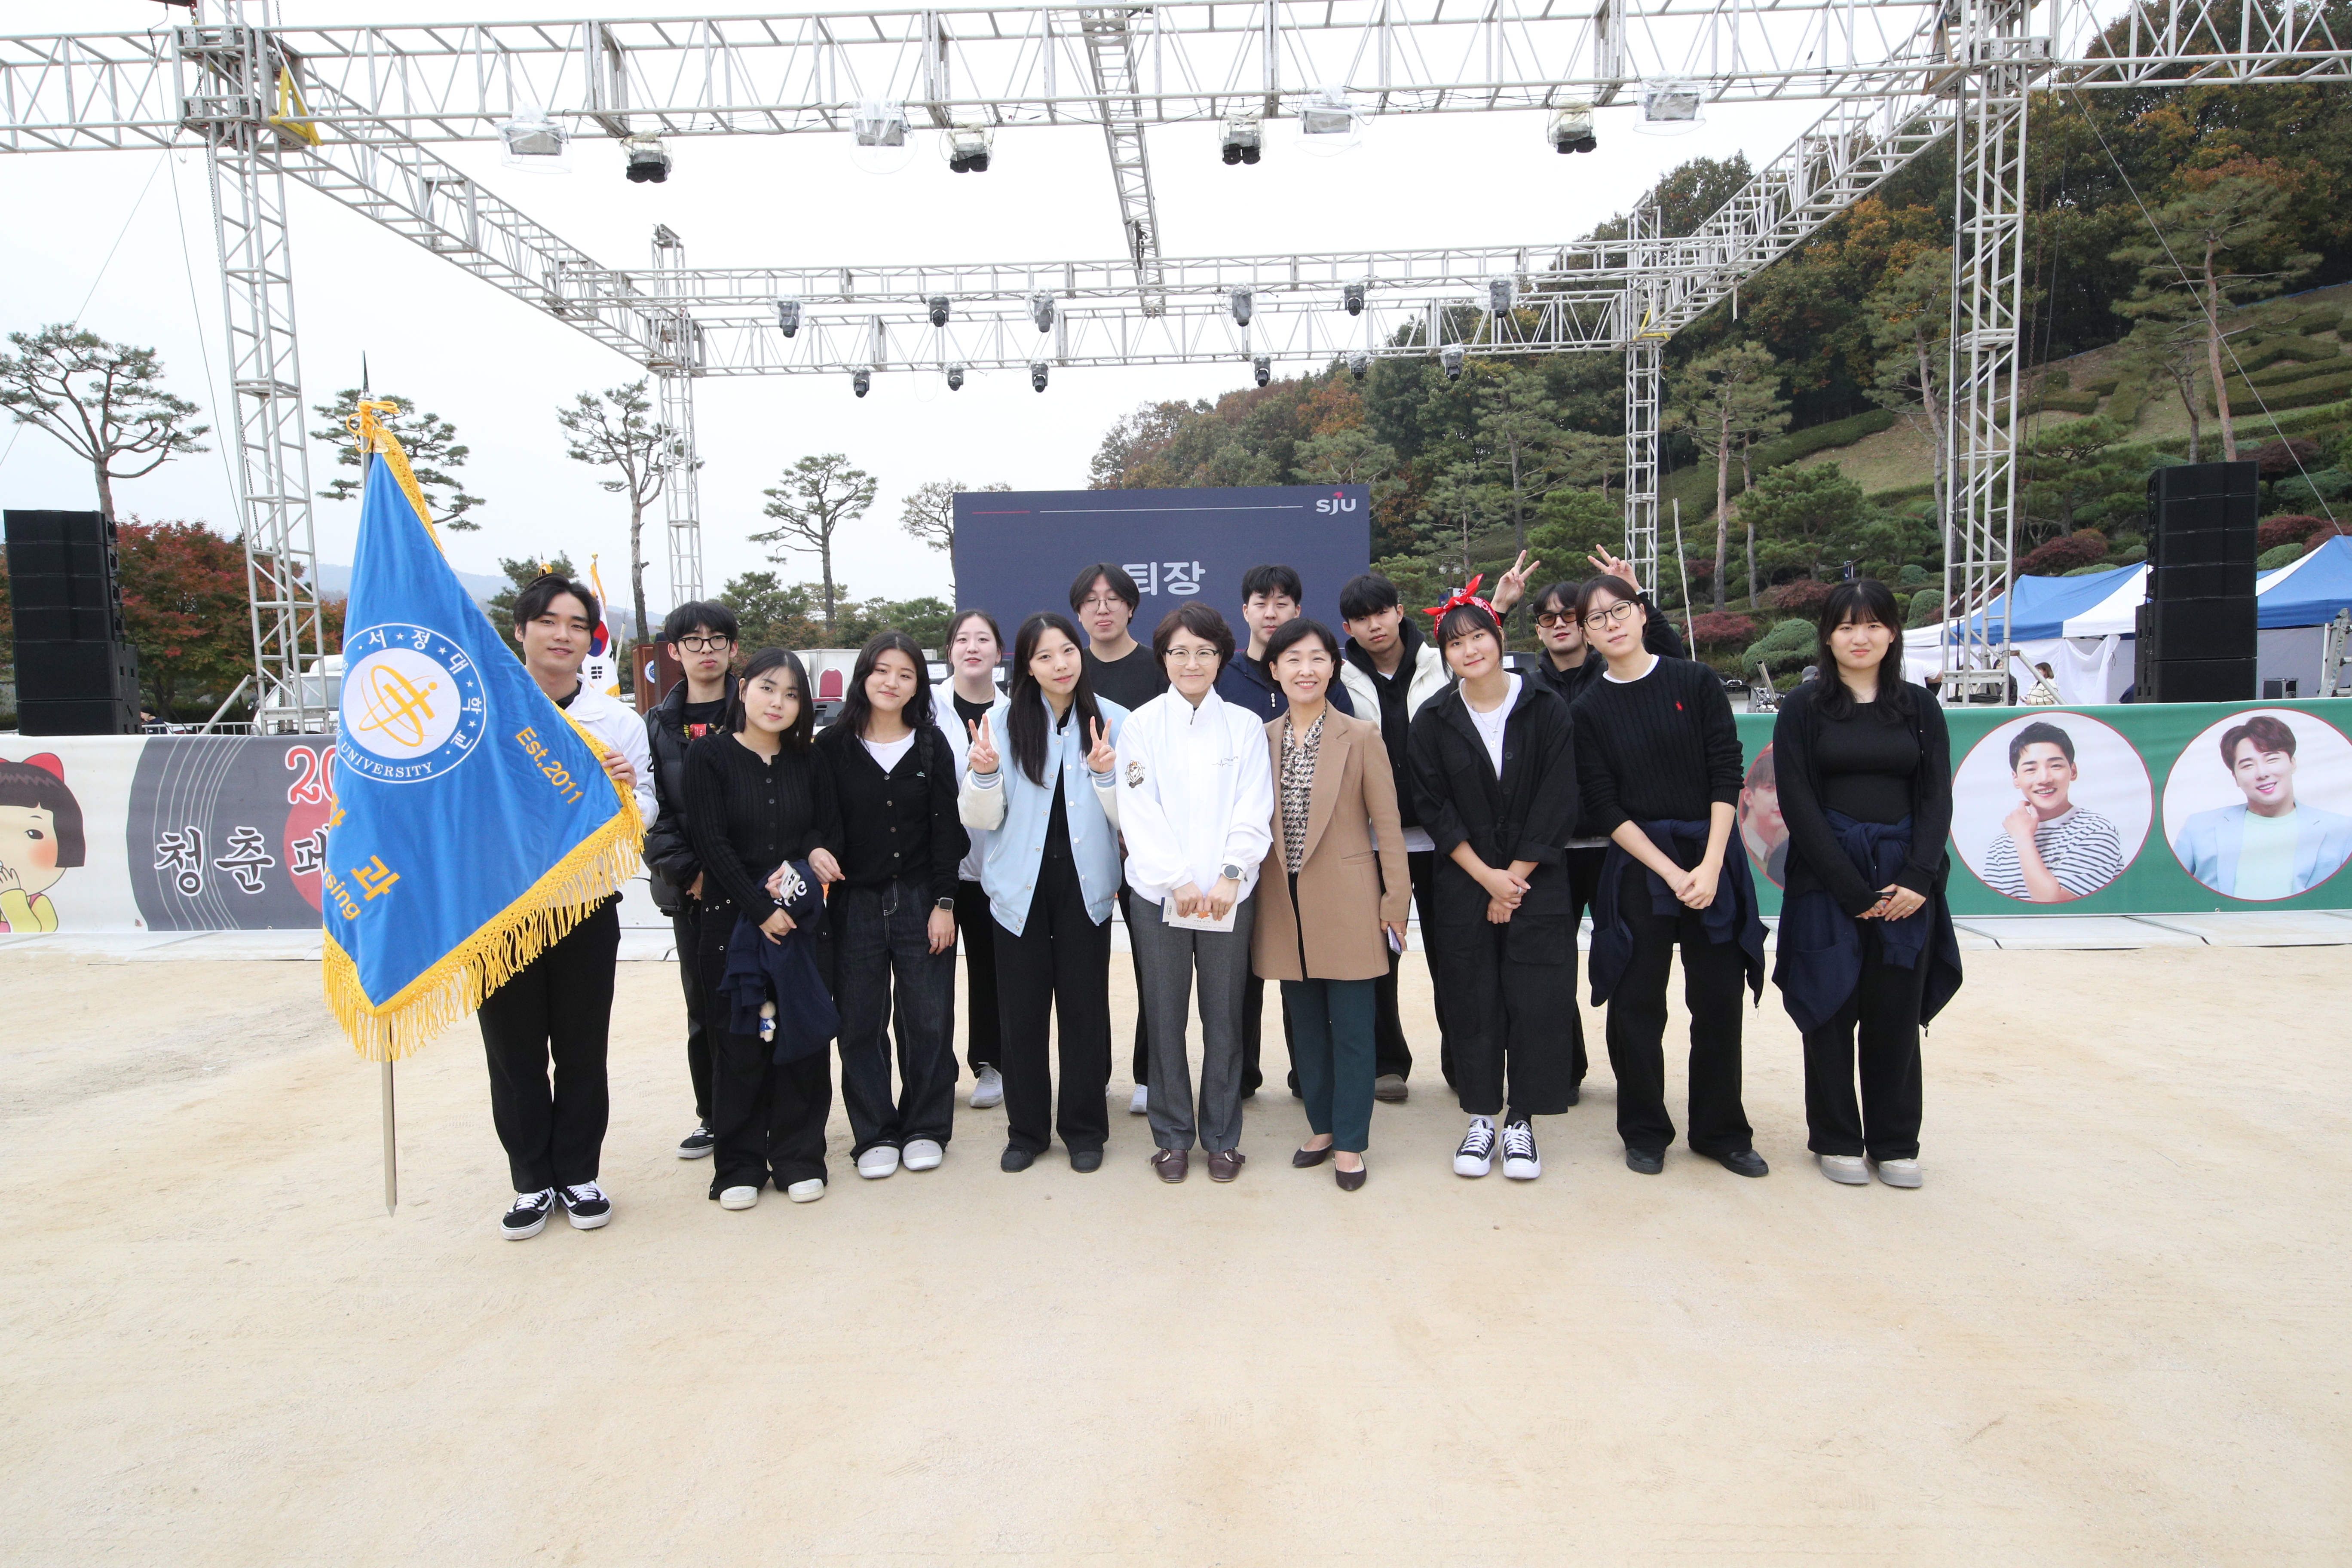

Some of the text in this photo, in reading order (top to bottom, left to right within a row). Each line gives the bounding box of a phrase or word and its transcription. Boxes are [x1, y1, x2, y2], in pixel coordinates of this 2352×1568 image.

[1122, 561, 1206, 596] 퇴장
[341, 741, 432, 777] UNIVERSITY
[154, 826, 275, 897] 청춘
